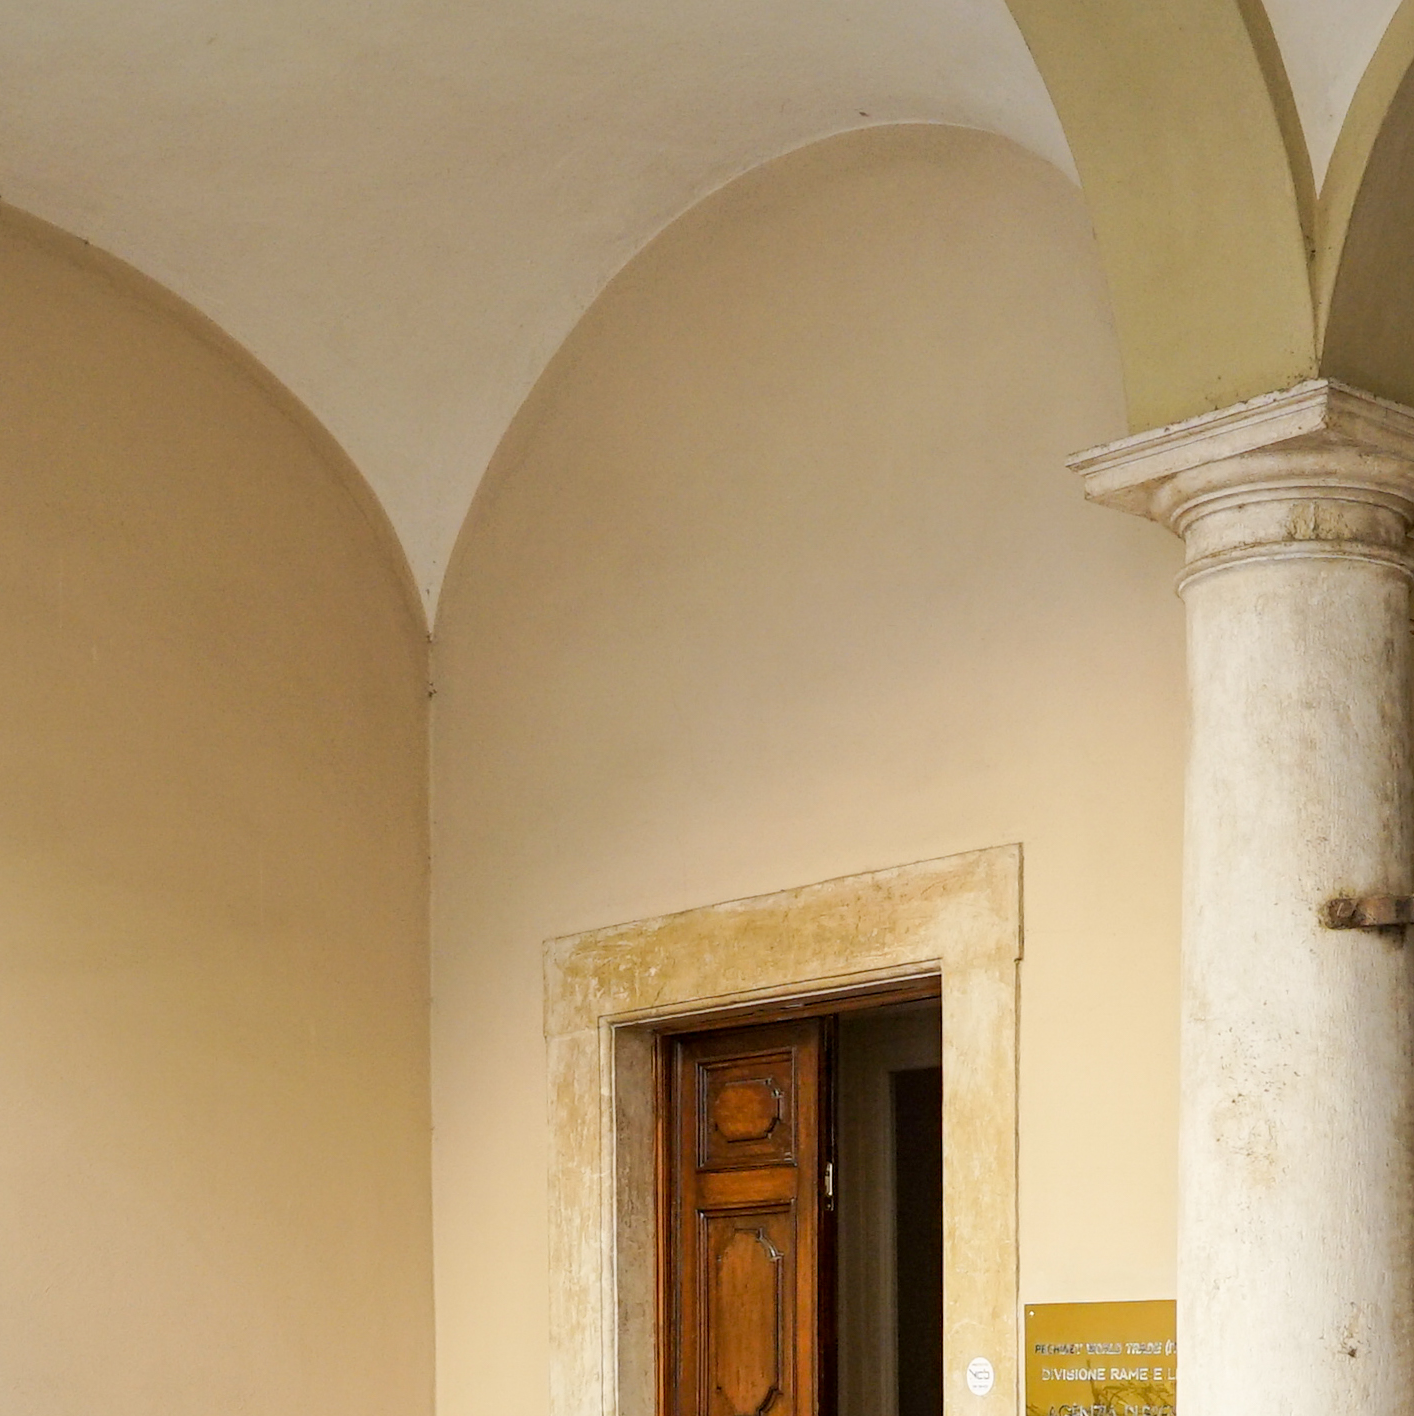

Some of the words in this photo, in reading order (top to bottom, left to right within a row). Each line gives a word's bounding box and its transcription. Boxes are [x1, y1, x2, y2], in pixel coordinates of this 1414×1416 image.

[1125, 1341, 1162, 1354] TRADE
[1042, 1368, 1106, 1381] DIVISIONE
[1110, 1367, 1148, 1380] RAME
[1153, 1367, 1163, 1380] E
